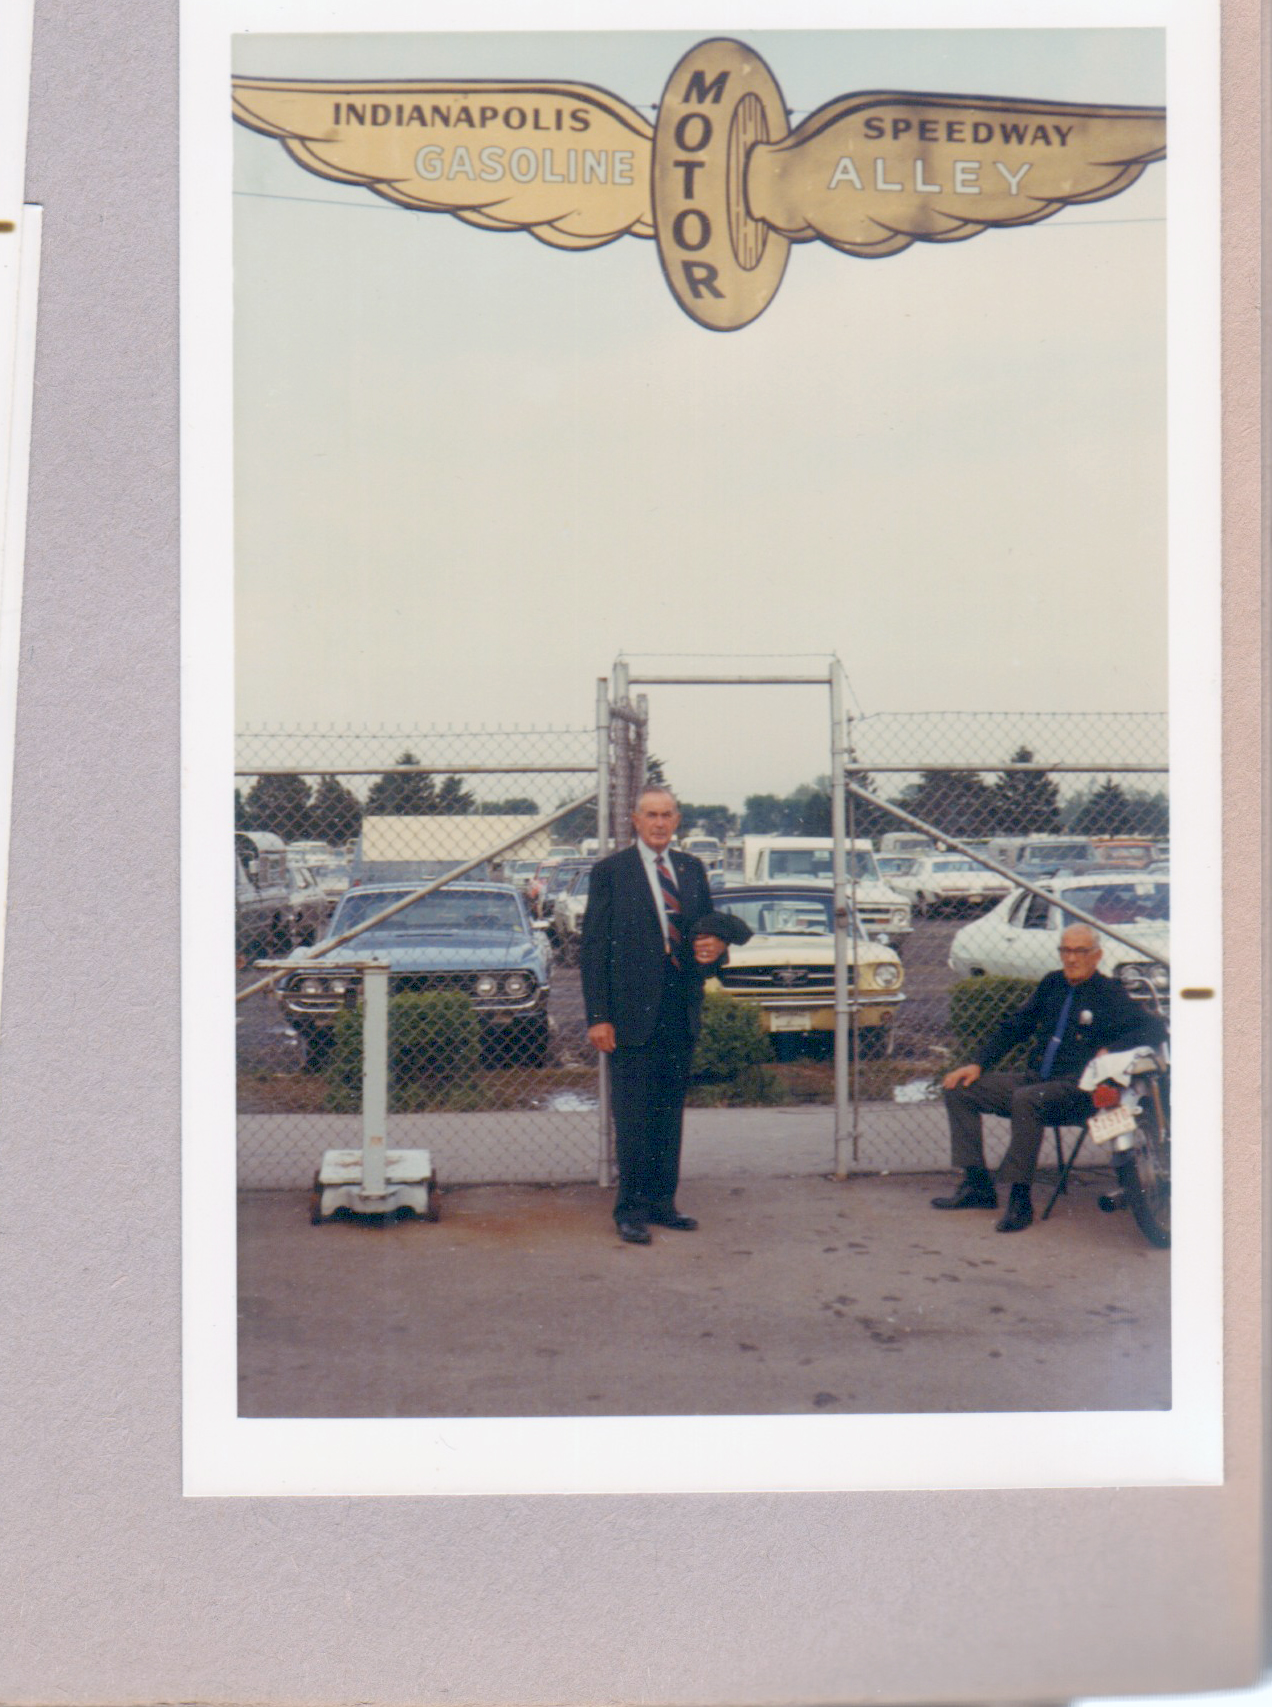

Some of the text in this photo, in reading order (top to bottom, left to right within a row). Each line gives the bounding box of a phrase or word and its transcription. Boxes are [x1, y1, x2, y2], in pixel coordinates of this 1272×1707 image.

[332, 102, 592, 133] INDIANAPOLIS
[862, 116, 1075, 148] SPEEDWAY
[413, 144, 636, 186] GASOLINE
[672, 69, 731, 300] MOTOR
[827, 156, 1034, 197] ALLEY
